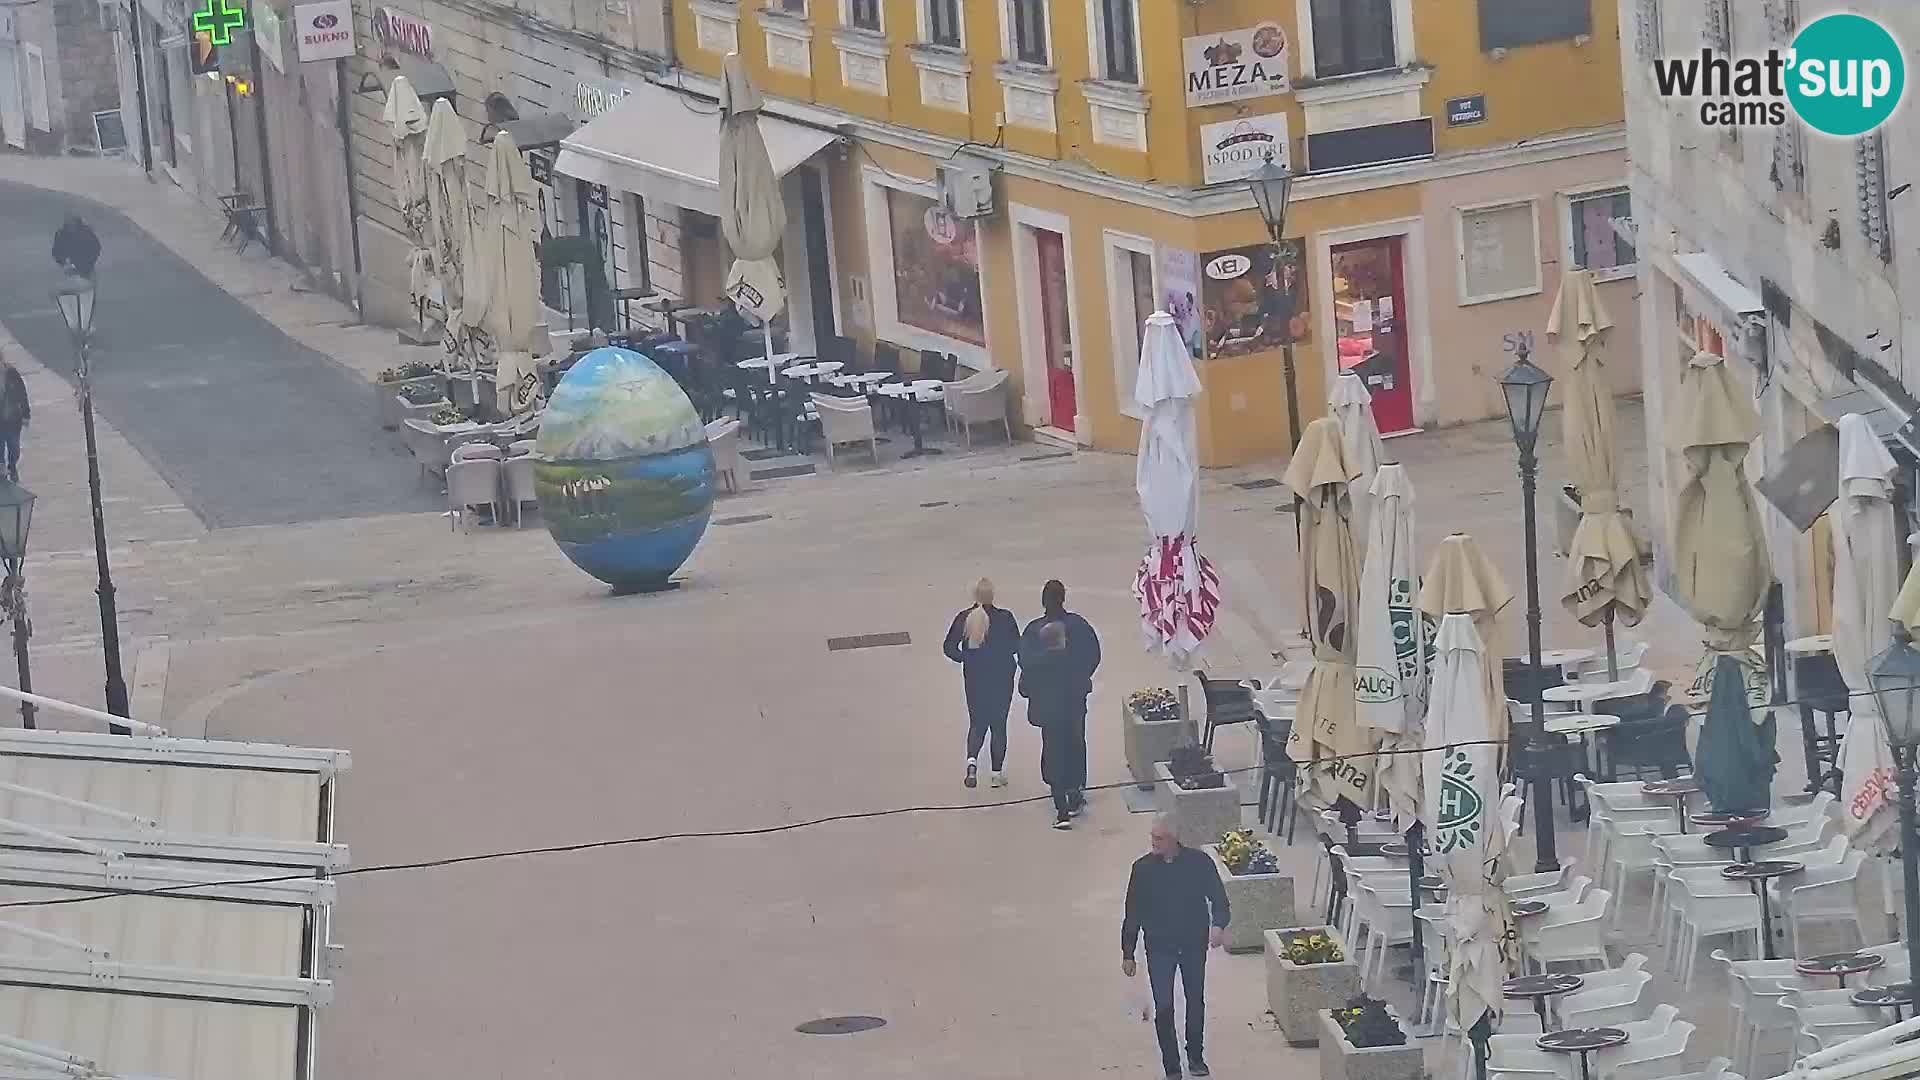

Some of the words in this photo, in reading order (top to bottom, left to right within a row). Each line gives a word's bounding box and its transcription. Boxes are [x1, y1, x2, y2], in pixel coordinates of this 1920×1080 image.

[304, 31, 349, 45] SUKNO
[391, 15, 431, 56] SUKNO
[1189, 62, 1267, 92] MEZA
[1207, 148, 1252, 166] ISPOD
